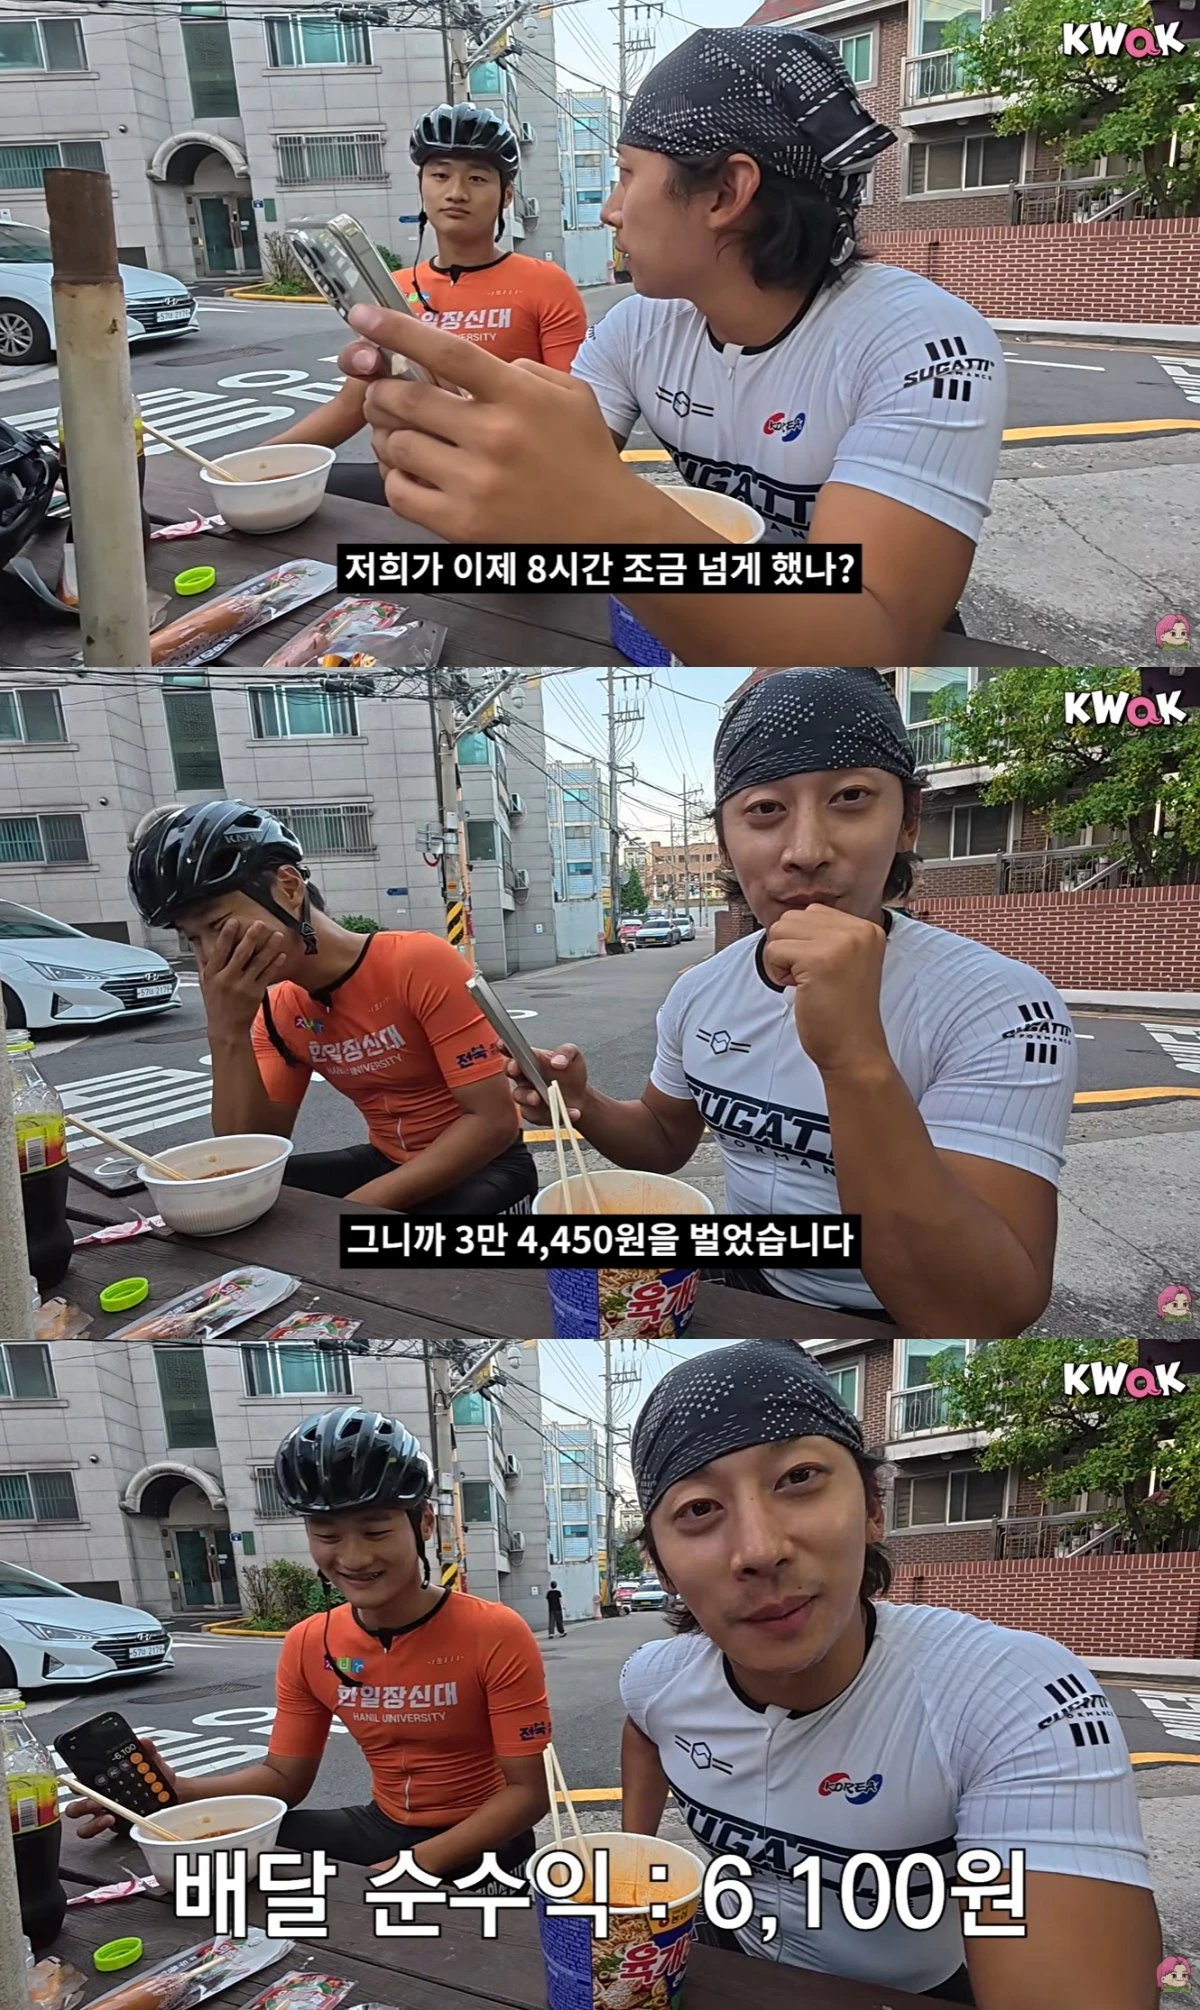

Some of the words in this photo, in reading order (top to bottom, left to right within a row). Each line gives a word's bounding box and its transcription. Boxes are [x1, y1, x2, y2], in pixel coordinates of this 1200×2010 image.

[418, 308, 511, 331] 일장신대
[626, 1270, 700, 1324] 육개
[337, 1681, 458, 1709] 한일장신대
[353, 1712, 379, 1722] HANIL
[382, 1712, 446, 1723] UNIVERSITY
[112, 1743, 137, 1761] -6,100
[824, 1780, 878, 1794] KOREA
[619, 1932, 694, 1985] 육개
